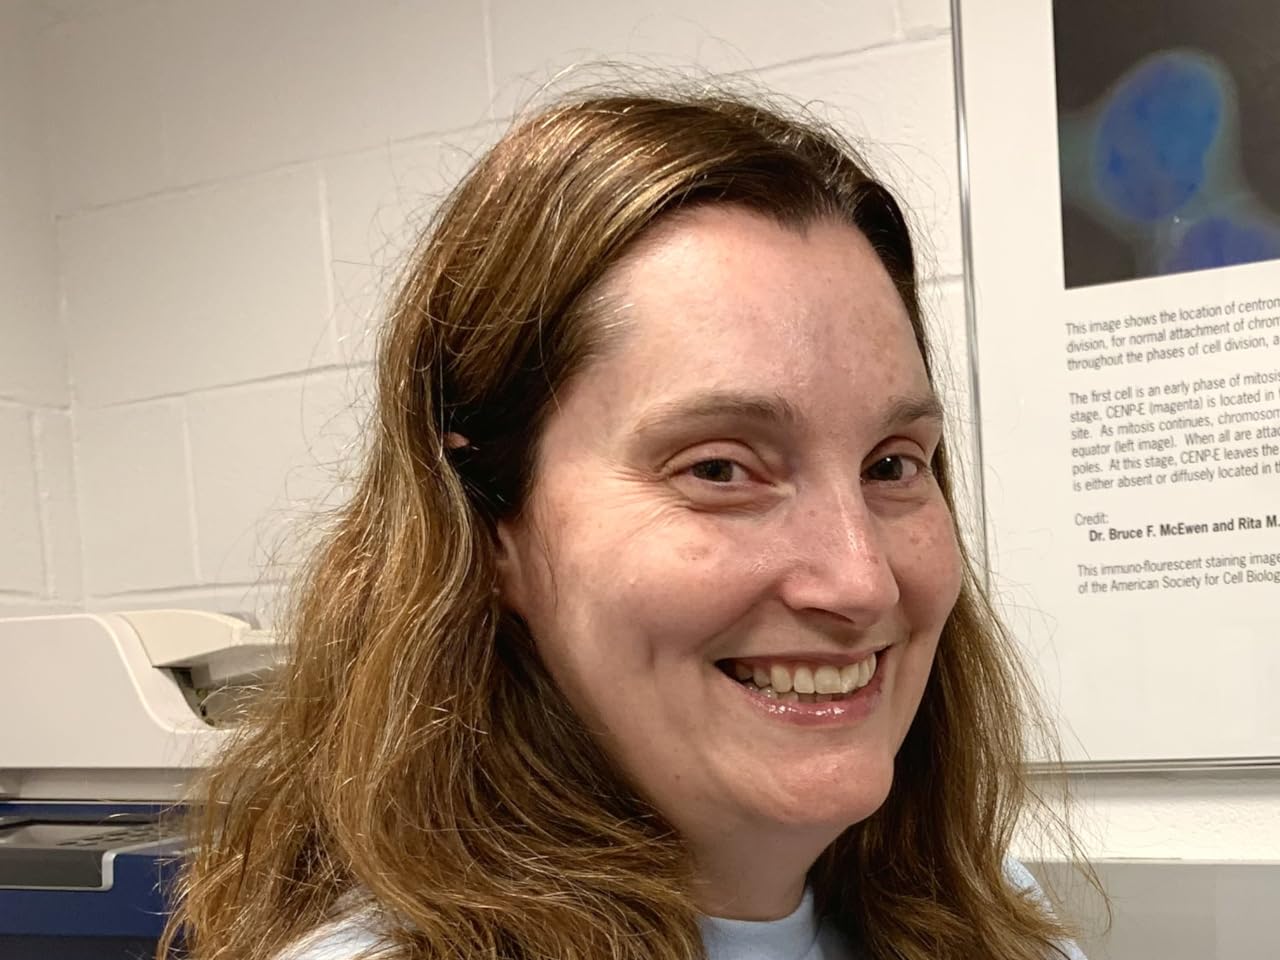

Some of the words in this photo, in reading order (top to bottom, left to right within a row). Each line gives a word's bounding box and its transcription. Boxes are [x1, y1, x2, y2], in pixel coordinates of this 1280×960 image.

[1088, 529, 1104, 541] Dr.
[1108, 528, 1143, 540] Bruce
[1146, 524, 1155, 537] F.
[1159, 522, 1208, 536] McEwen
[1212, 518, 1234, 532] and
[1238, 517, 1261, 529] Rita
[1265, 514, 1280, 527] M.
